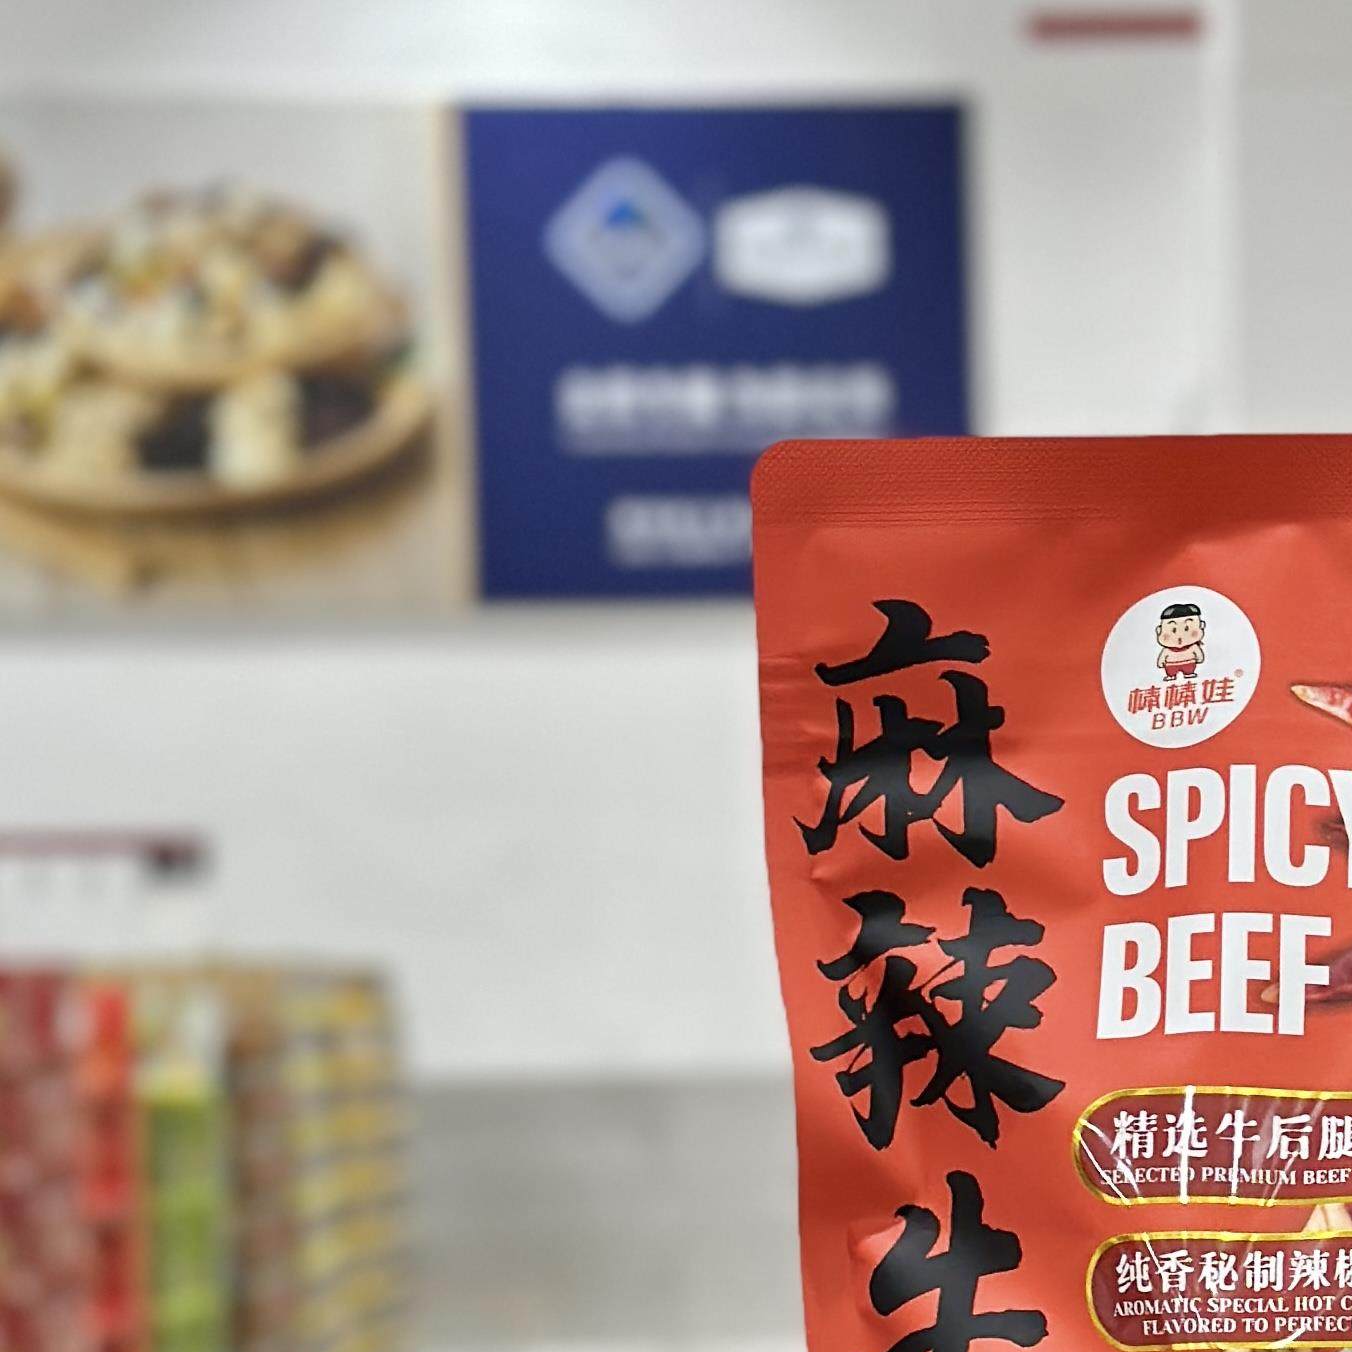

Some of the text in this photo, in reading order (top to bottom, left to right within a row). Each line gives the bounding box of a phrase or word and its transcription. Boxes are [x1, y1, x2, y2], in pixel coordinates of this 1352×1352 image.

[1127, 679, 1235, 713] 棒棒娃
[1151, 708, 1209, 730] BBW
[1096, 912, 1332, 1040] BEEF
[1201, 1166, 1297, 1186] PREMIUM
[1303, 1167, 1352, 1185] BEEF
[1113, 1298, 1201, 1317] AROMATIC
[1206, 1297, 1290, 1314] SPECIAL
[1294, 1296, 1337, 1312] HOT
[1142, 1316, 1238, 1336] FLAVORED
[1241, 1317, 1270, 1334] TO
